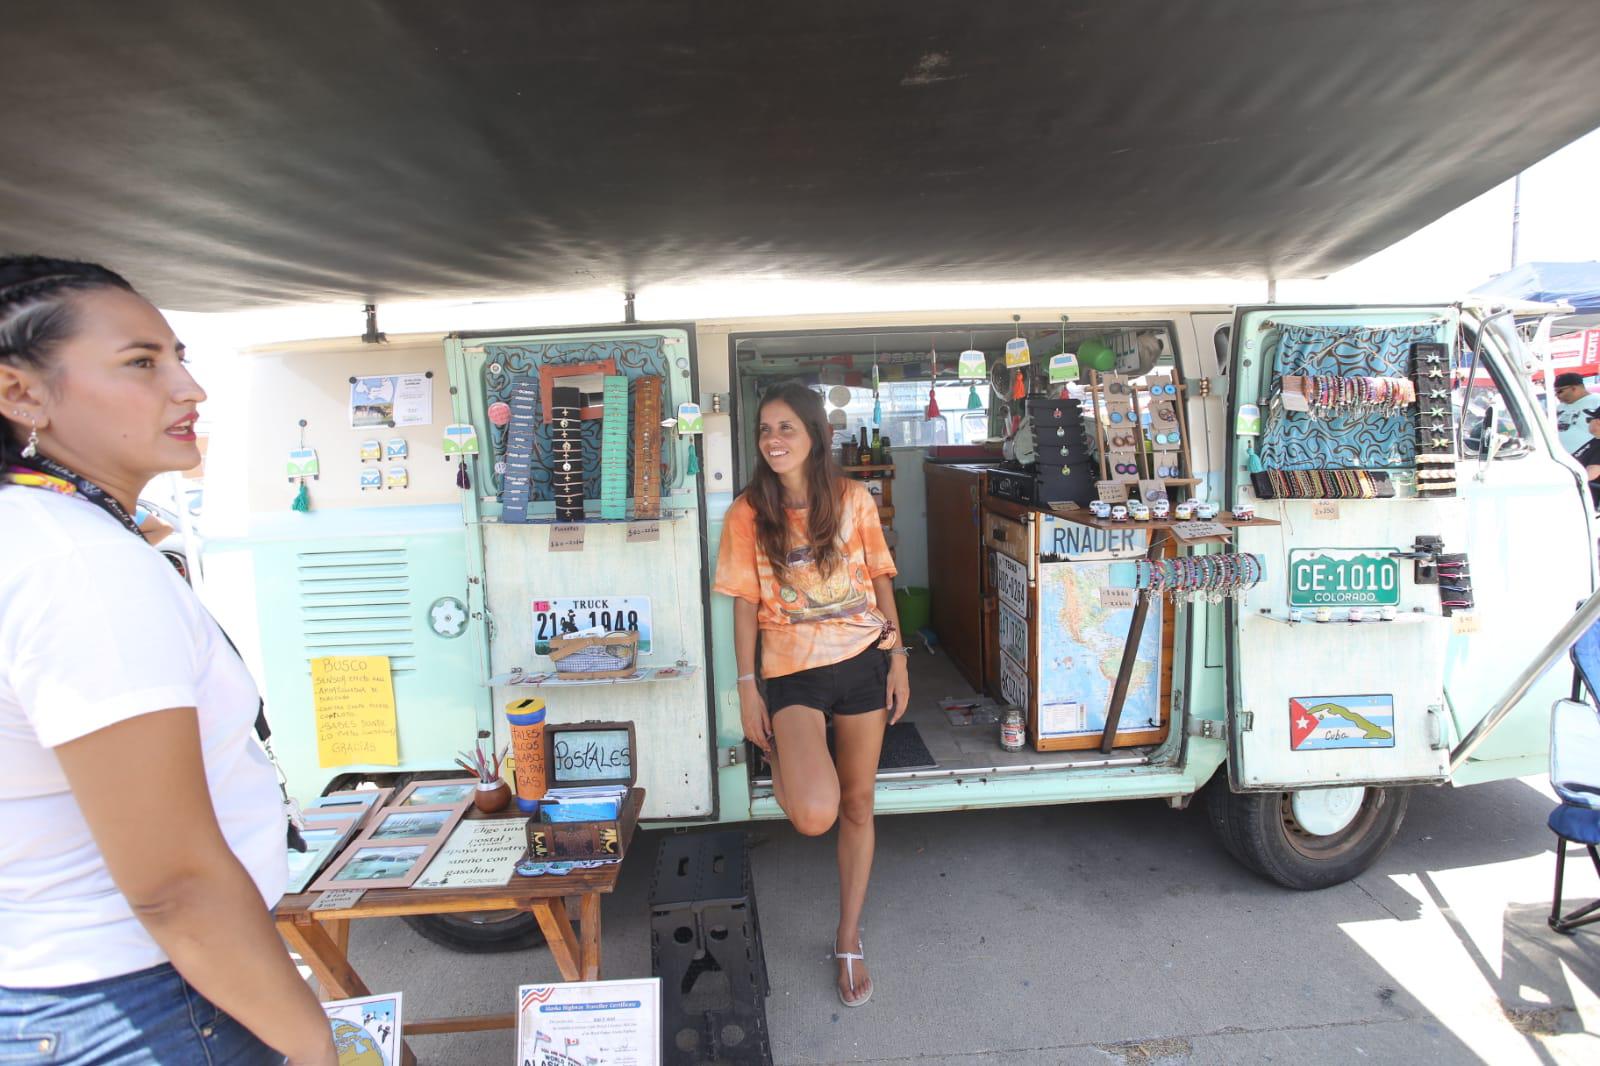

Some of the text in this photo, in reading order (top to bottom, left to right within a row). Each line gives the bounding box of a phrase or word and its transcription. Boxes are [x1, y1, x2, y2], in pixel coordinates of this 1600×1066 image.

[1314, 592, 1376, 602] COLORADO
[573, 600, 609, 609] TRUCK
[537, 610, 638, 640] 21 1948
[322, 658, 368, 673] BUSCO
[1325, 729, 1349, 741] Cuba
[331, 741, 377, 753] GRACIAS
[467, 835, 505, 846] postal
[444, 866, 496, 877] gasolina
